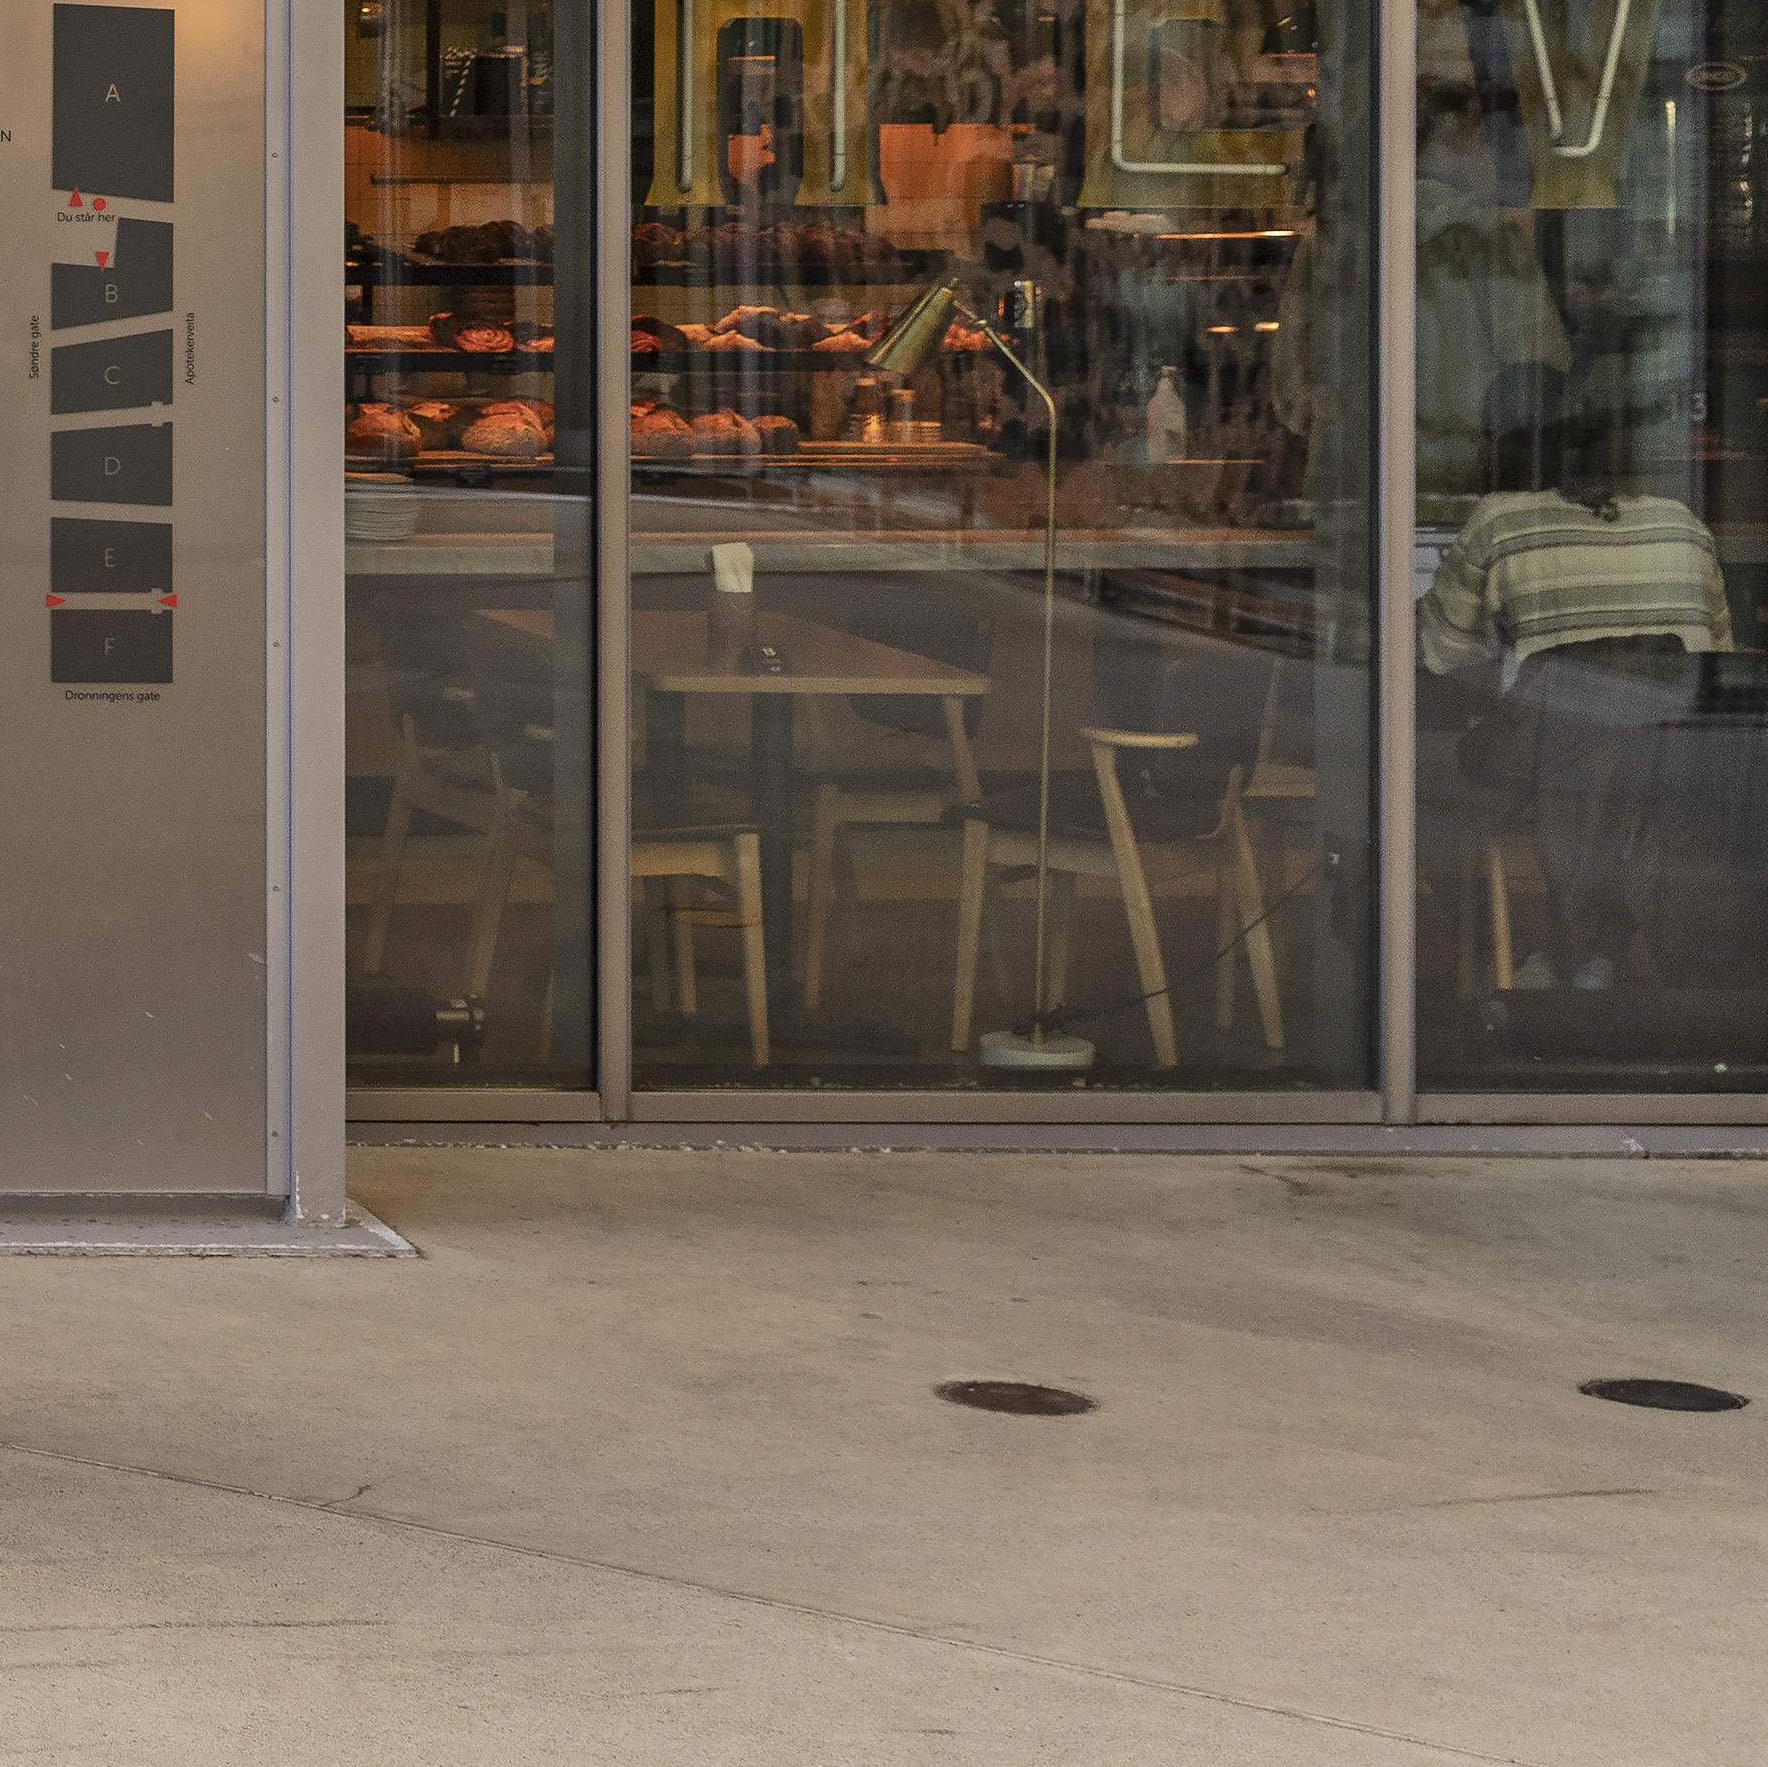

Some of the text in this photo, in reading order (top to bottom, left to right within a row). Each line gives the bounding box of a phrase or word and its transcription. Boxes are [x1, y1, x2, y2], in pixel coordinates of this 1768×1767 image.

[104, 83, 121, 103] A
[56, 211, 115, 223] Du står her
[105, 283, 118, 303] B
[28, 315, 42, 380] Søndre gate
[184, 312, 196, 385] Apotekerveita
[103, 365, 120, 386] C
[104, 456, 122, 476] D
[104, 547, 115, 568] E
[64, 689, 161, 704] Dronningens gate
